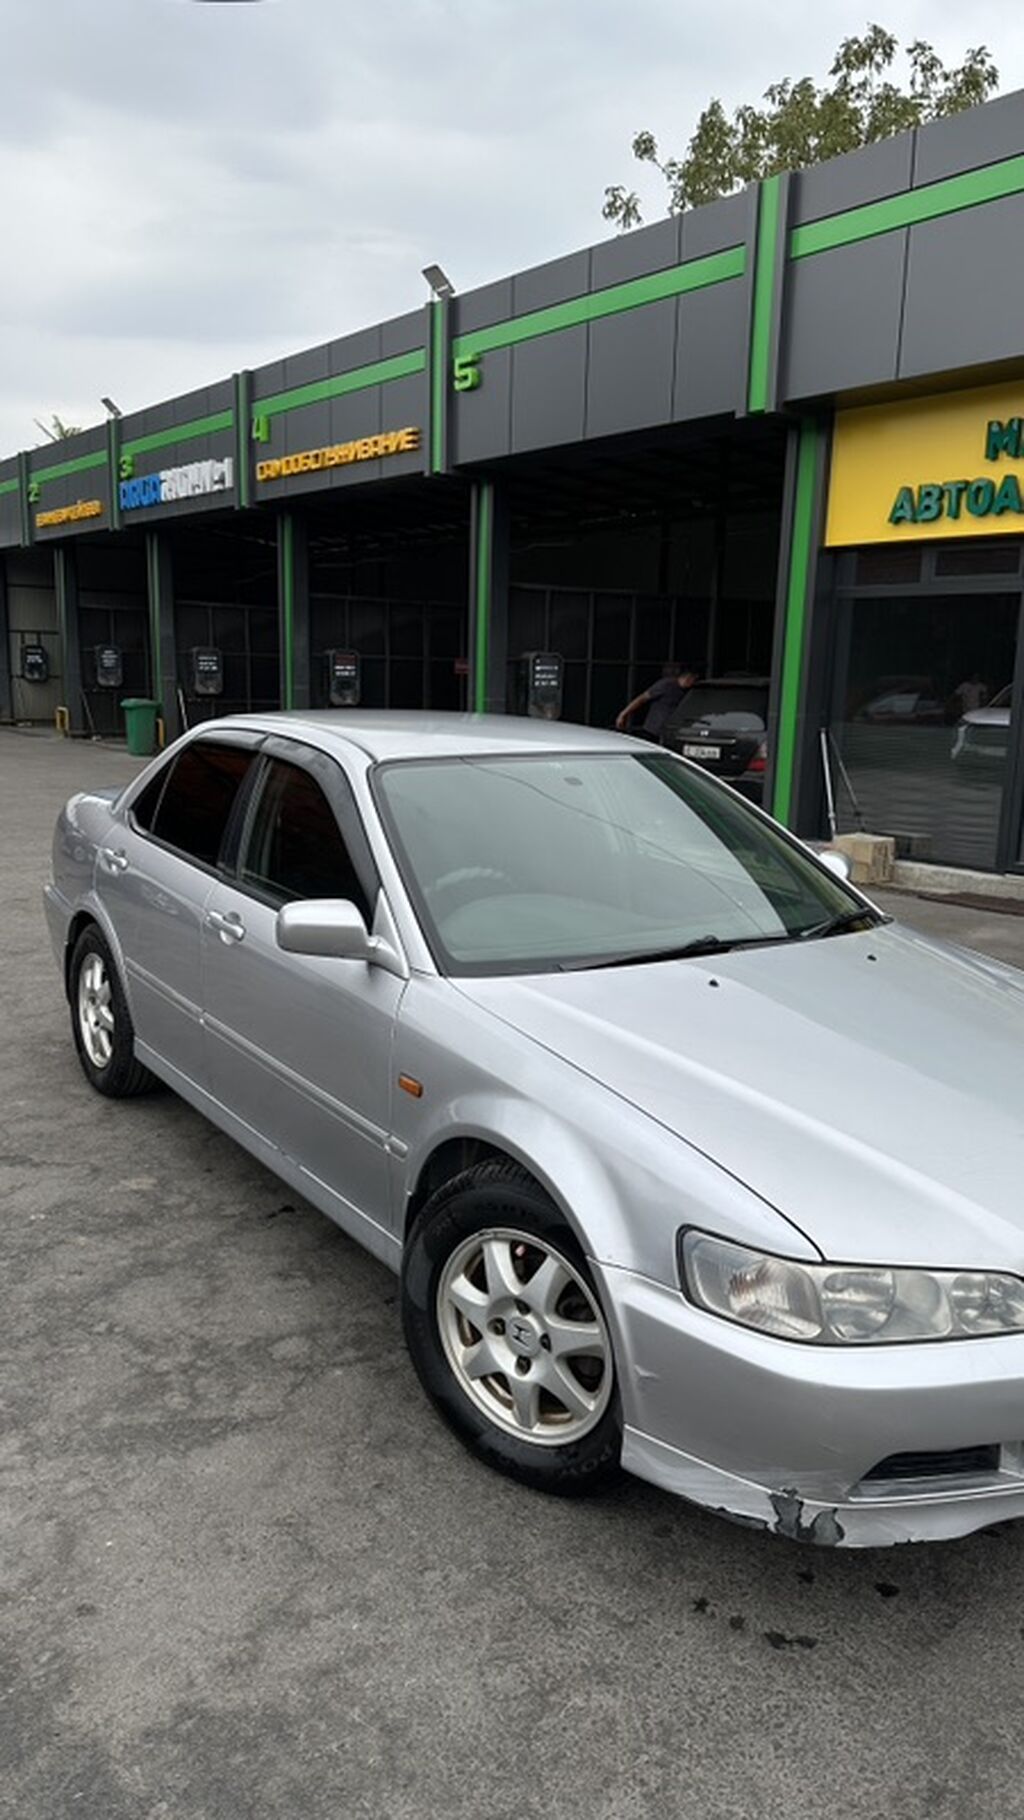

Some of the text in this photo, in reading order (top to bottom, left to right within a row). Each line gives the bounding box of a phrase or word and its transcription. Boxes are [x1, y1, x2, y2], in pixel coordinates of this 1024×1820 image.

[454, 356, 480, 391] 5
[252, 415, 270, 442] 4
[984, 417, 1024, 461] М
[119, 455, 134, 479] 3
[28, 482, 41, 503] 2
[888, 474, 1024, 525] АВТОА
